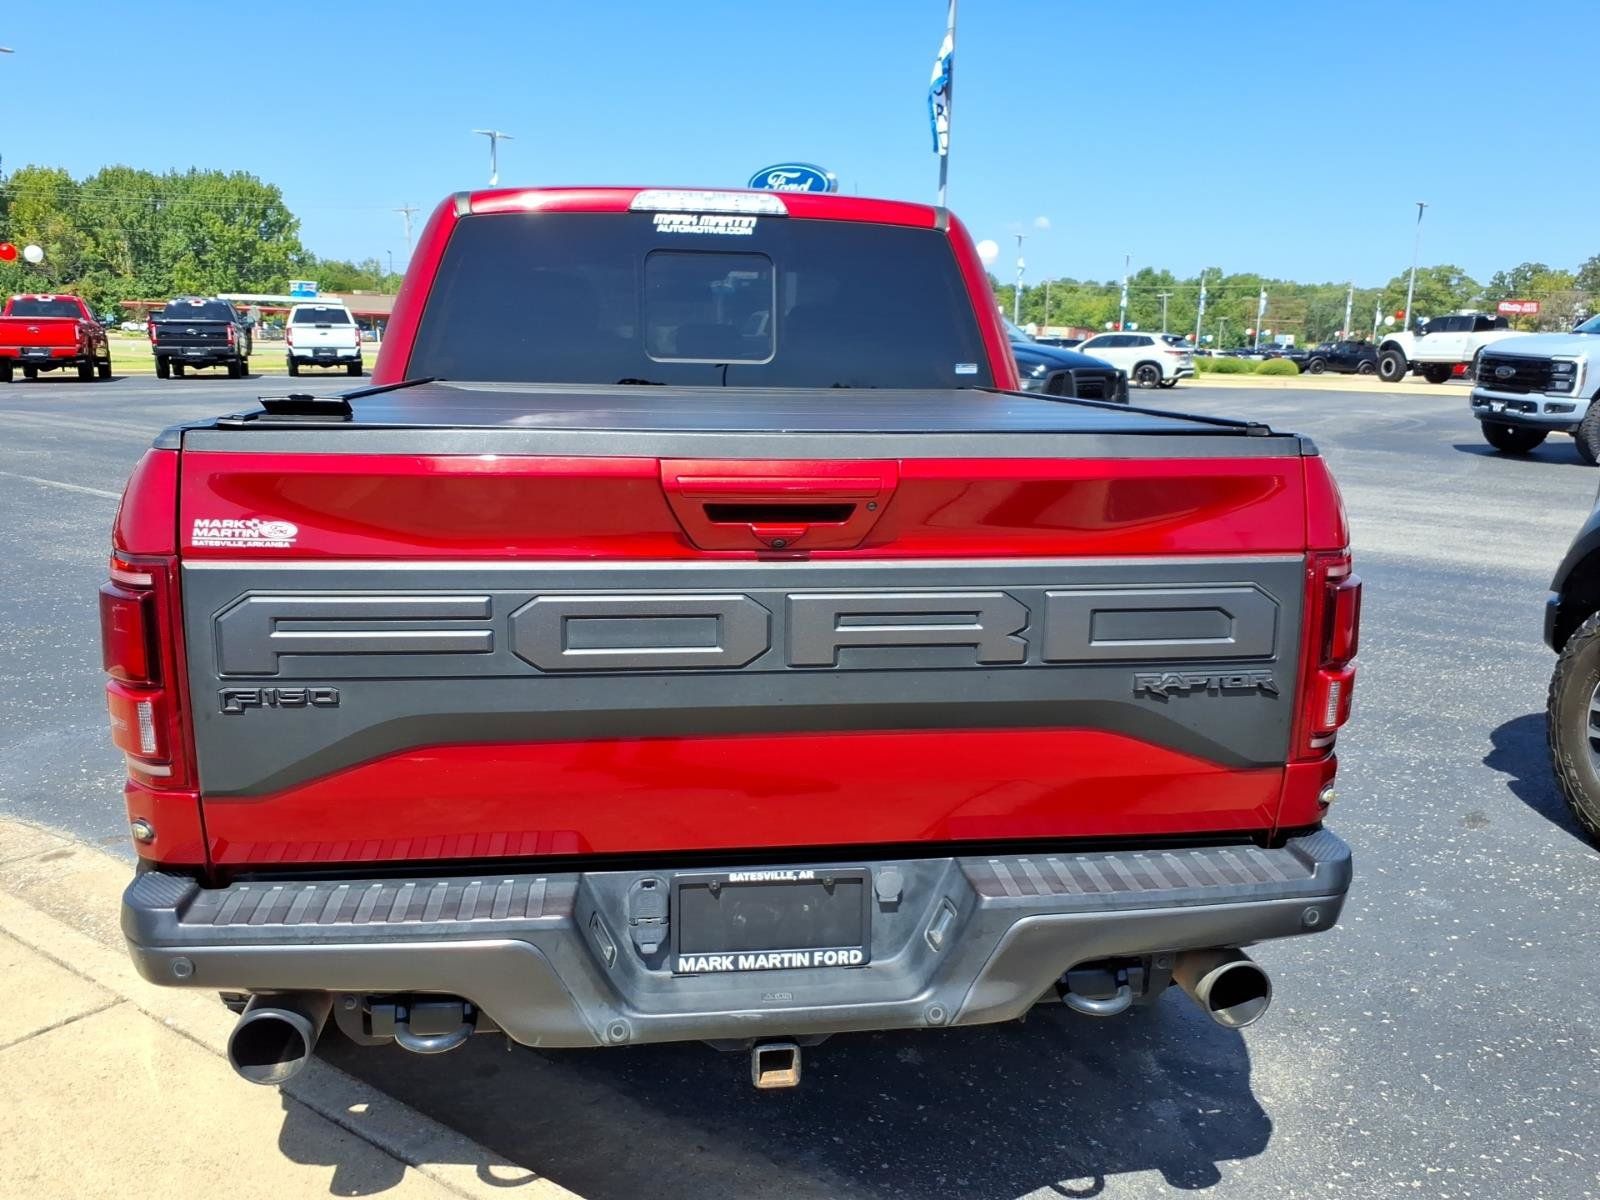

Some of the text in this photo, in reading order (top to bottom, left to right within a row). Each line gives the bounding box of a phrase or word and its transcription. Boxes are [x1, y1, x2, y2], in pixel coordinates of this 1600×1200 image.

[194, 519, 246, 529] MARK
[192, 528, 259, 538] MARTIN
[214, 586, 1280, 676] FORD
[1133, 669, 1281, 700] RAPTOR
[728, 870, 815, 882] BATESVILLE, AR
[678, 950, 863, 973] MARK MARTIN FORD
